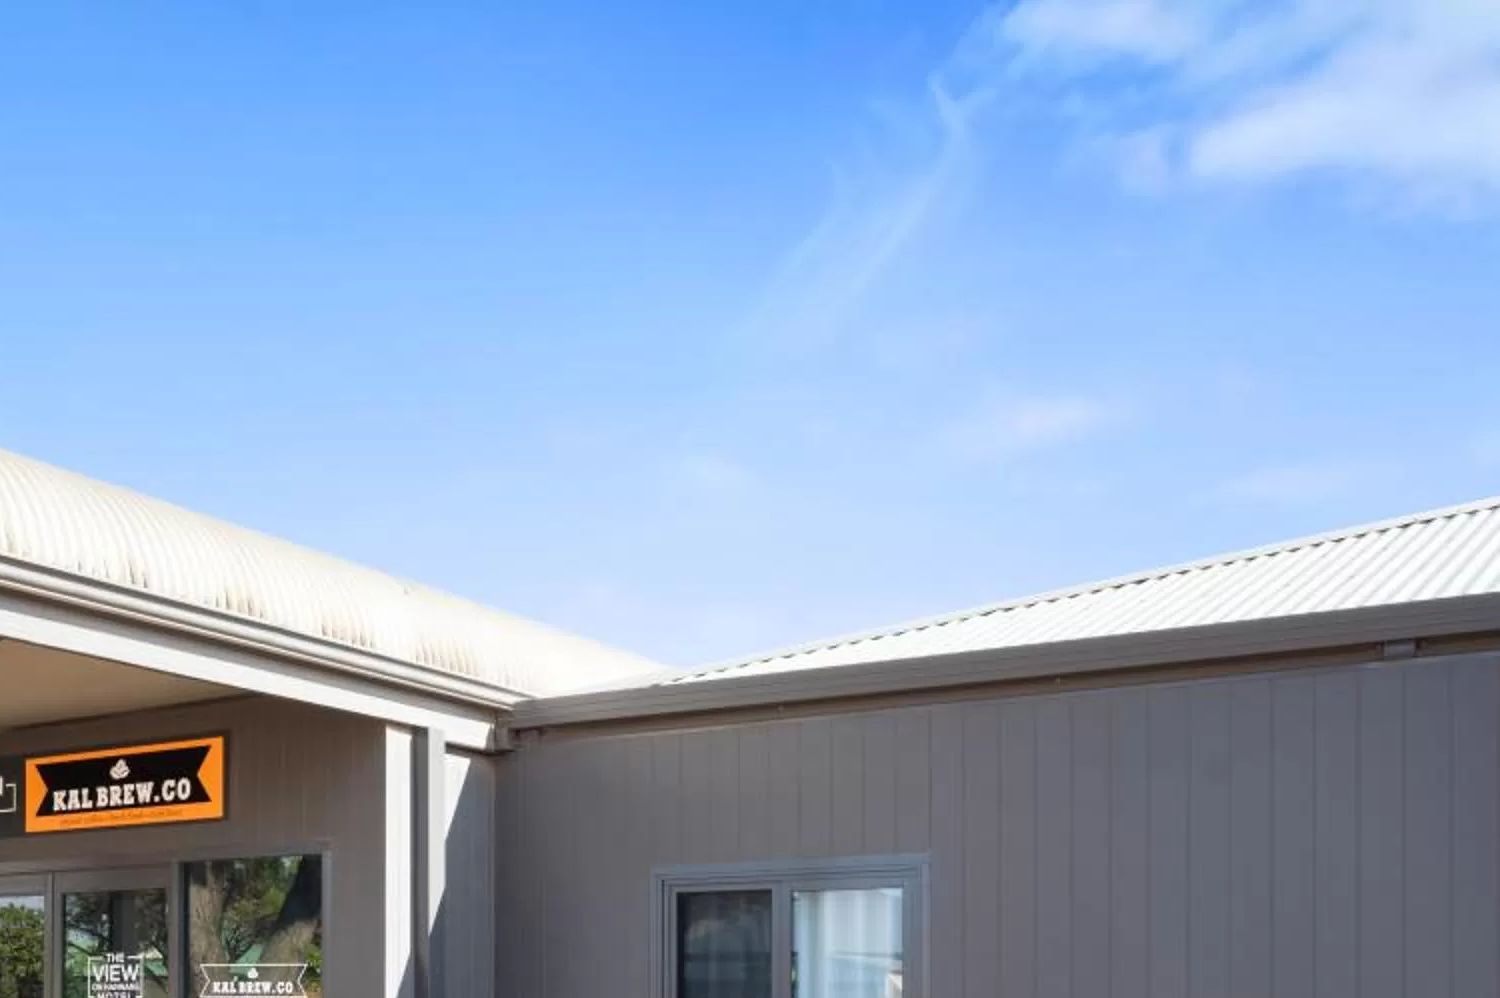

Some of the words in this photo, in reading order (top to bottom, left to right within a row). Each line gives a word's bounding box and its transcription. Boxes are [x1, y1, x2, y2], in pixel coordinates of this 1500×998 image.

[52, 787, 93, 811] KAL
[96, 777, 192, 808] BREW.CO
[106, 952, 125, 963] THE
[91, 963, 139, 982] VIEW
[212, 981, 237, 993] KAL
[238, 981, 294, 994] BREW.CO
